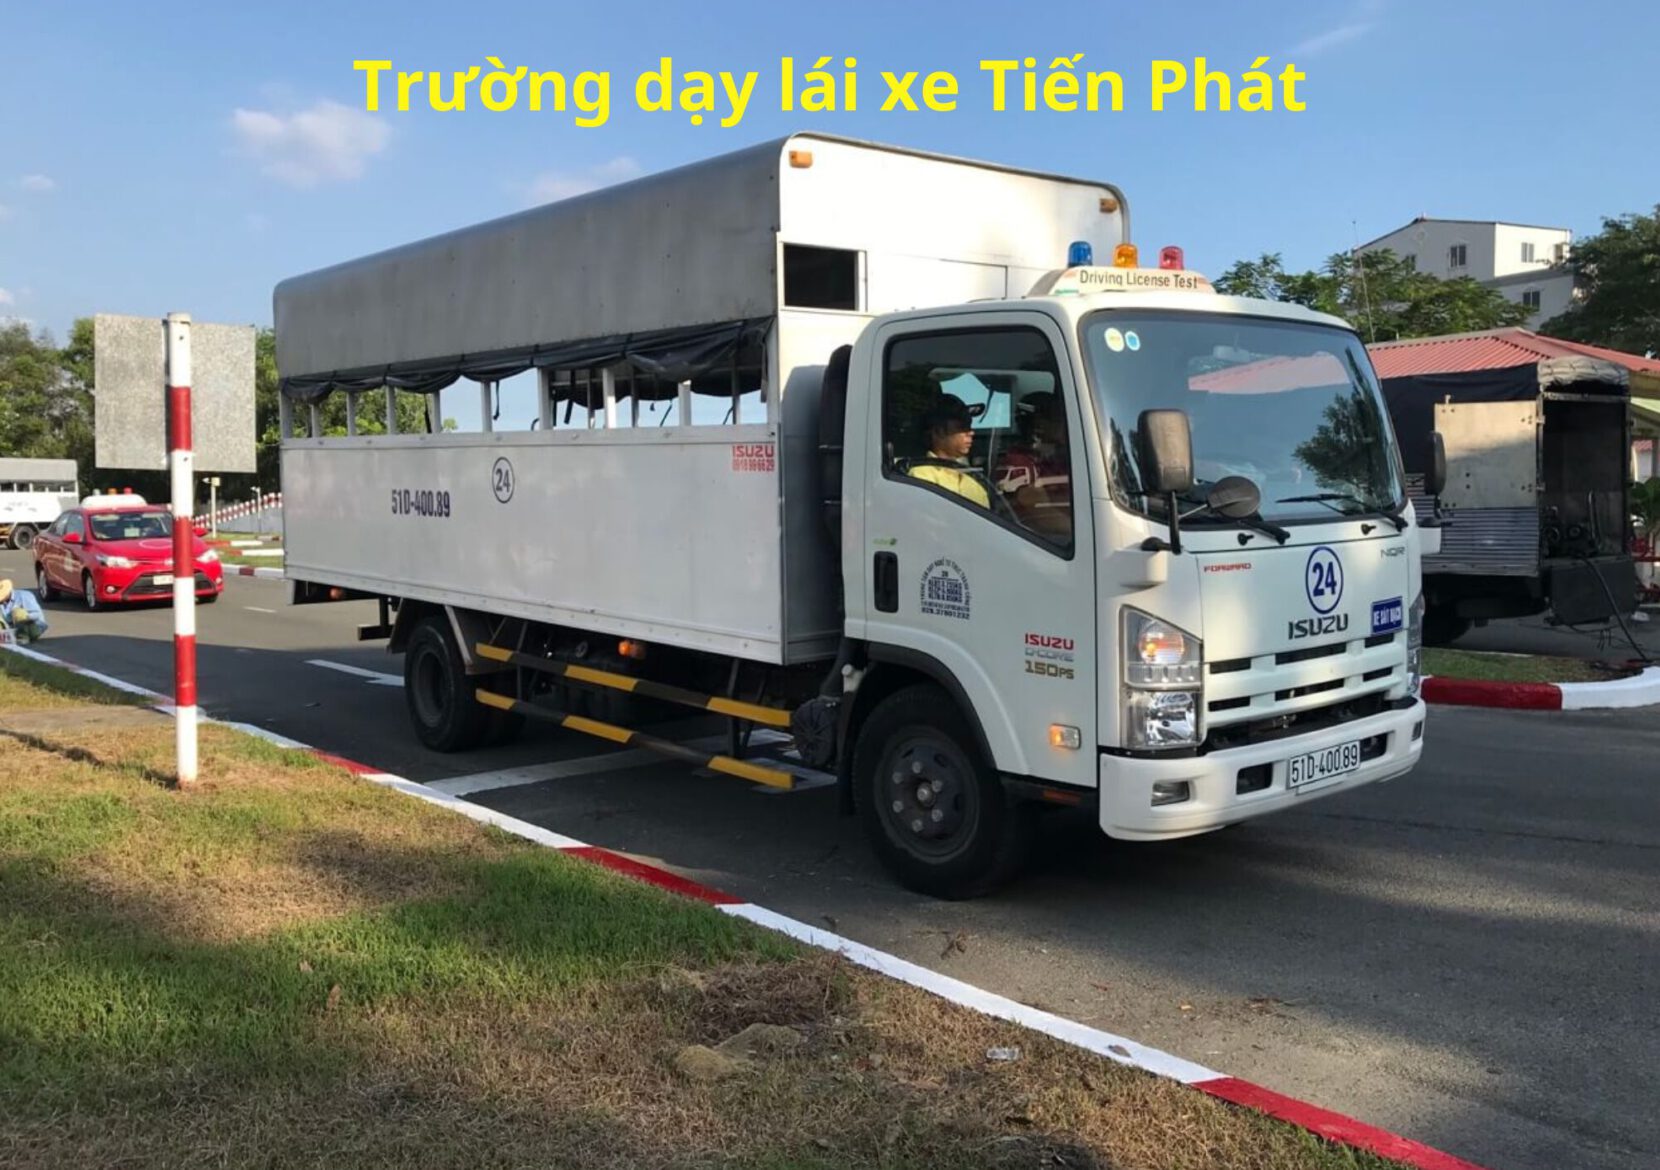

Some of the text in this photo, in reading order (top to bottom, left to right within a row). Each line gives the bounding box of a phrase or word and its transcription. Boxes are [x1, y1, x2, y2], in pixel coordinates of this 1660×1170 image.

[1079, 269, 1198, 289] Driving License Test
[732, 444, 775, 458] ISUZU
[495, 467, 511, 493] 24
[391, 488, 451, 518] 51D-400.89
[1203, 562, 1252, 573] FORWARD
[1312, 561, 1337, 598] 24
[1288, 613, 1349, 640] ISUZU
[1025, 632, 1074, 651] ISUZU
[1291, 743, 1358, 784] 51D-400.89
